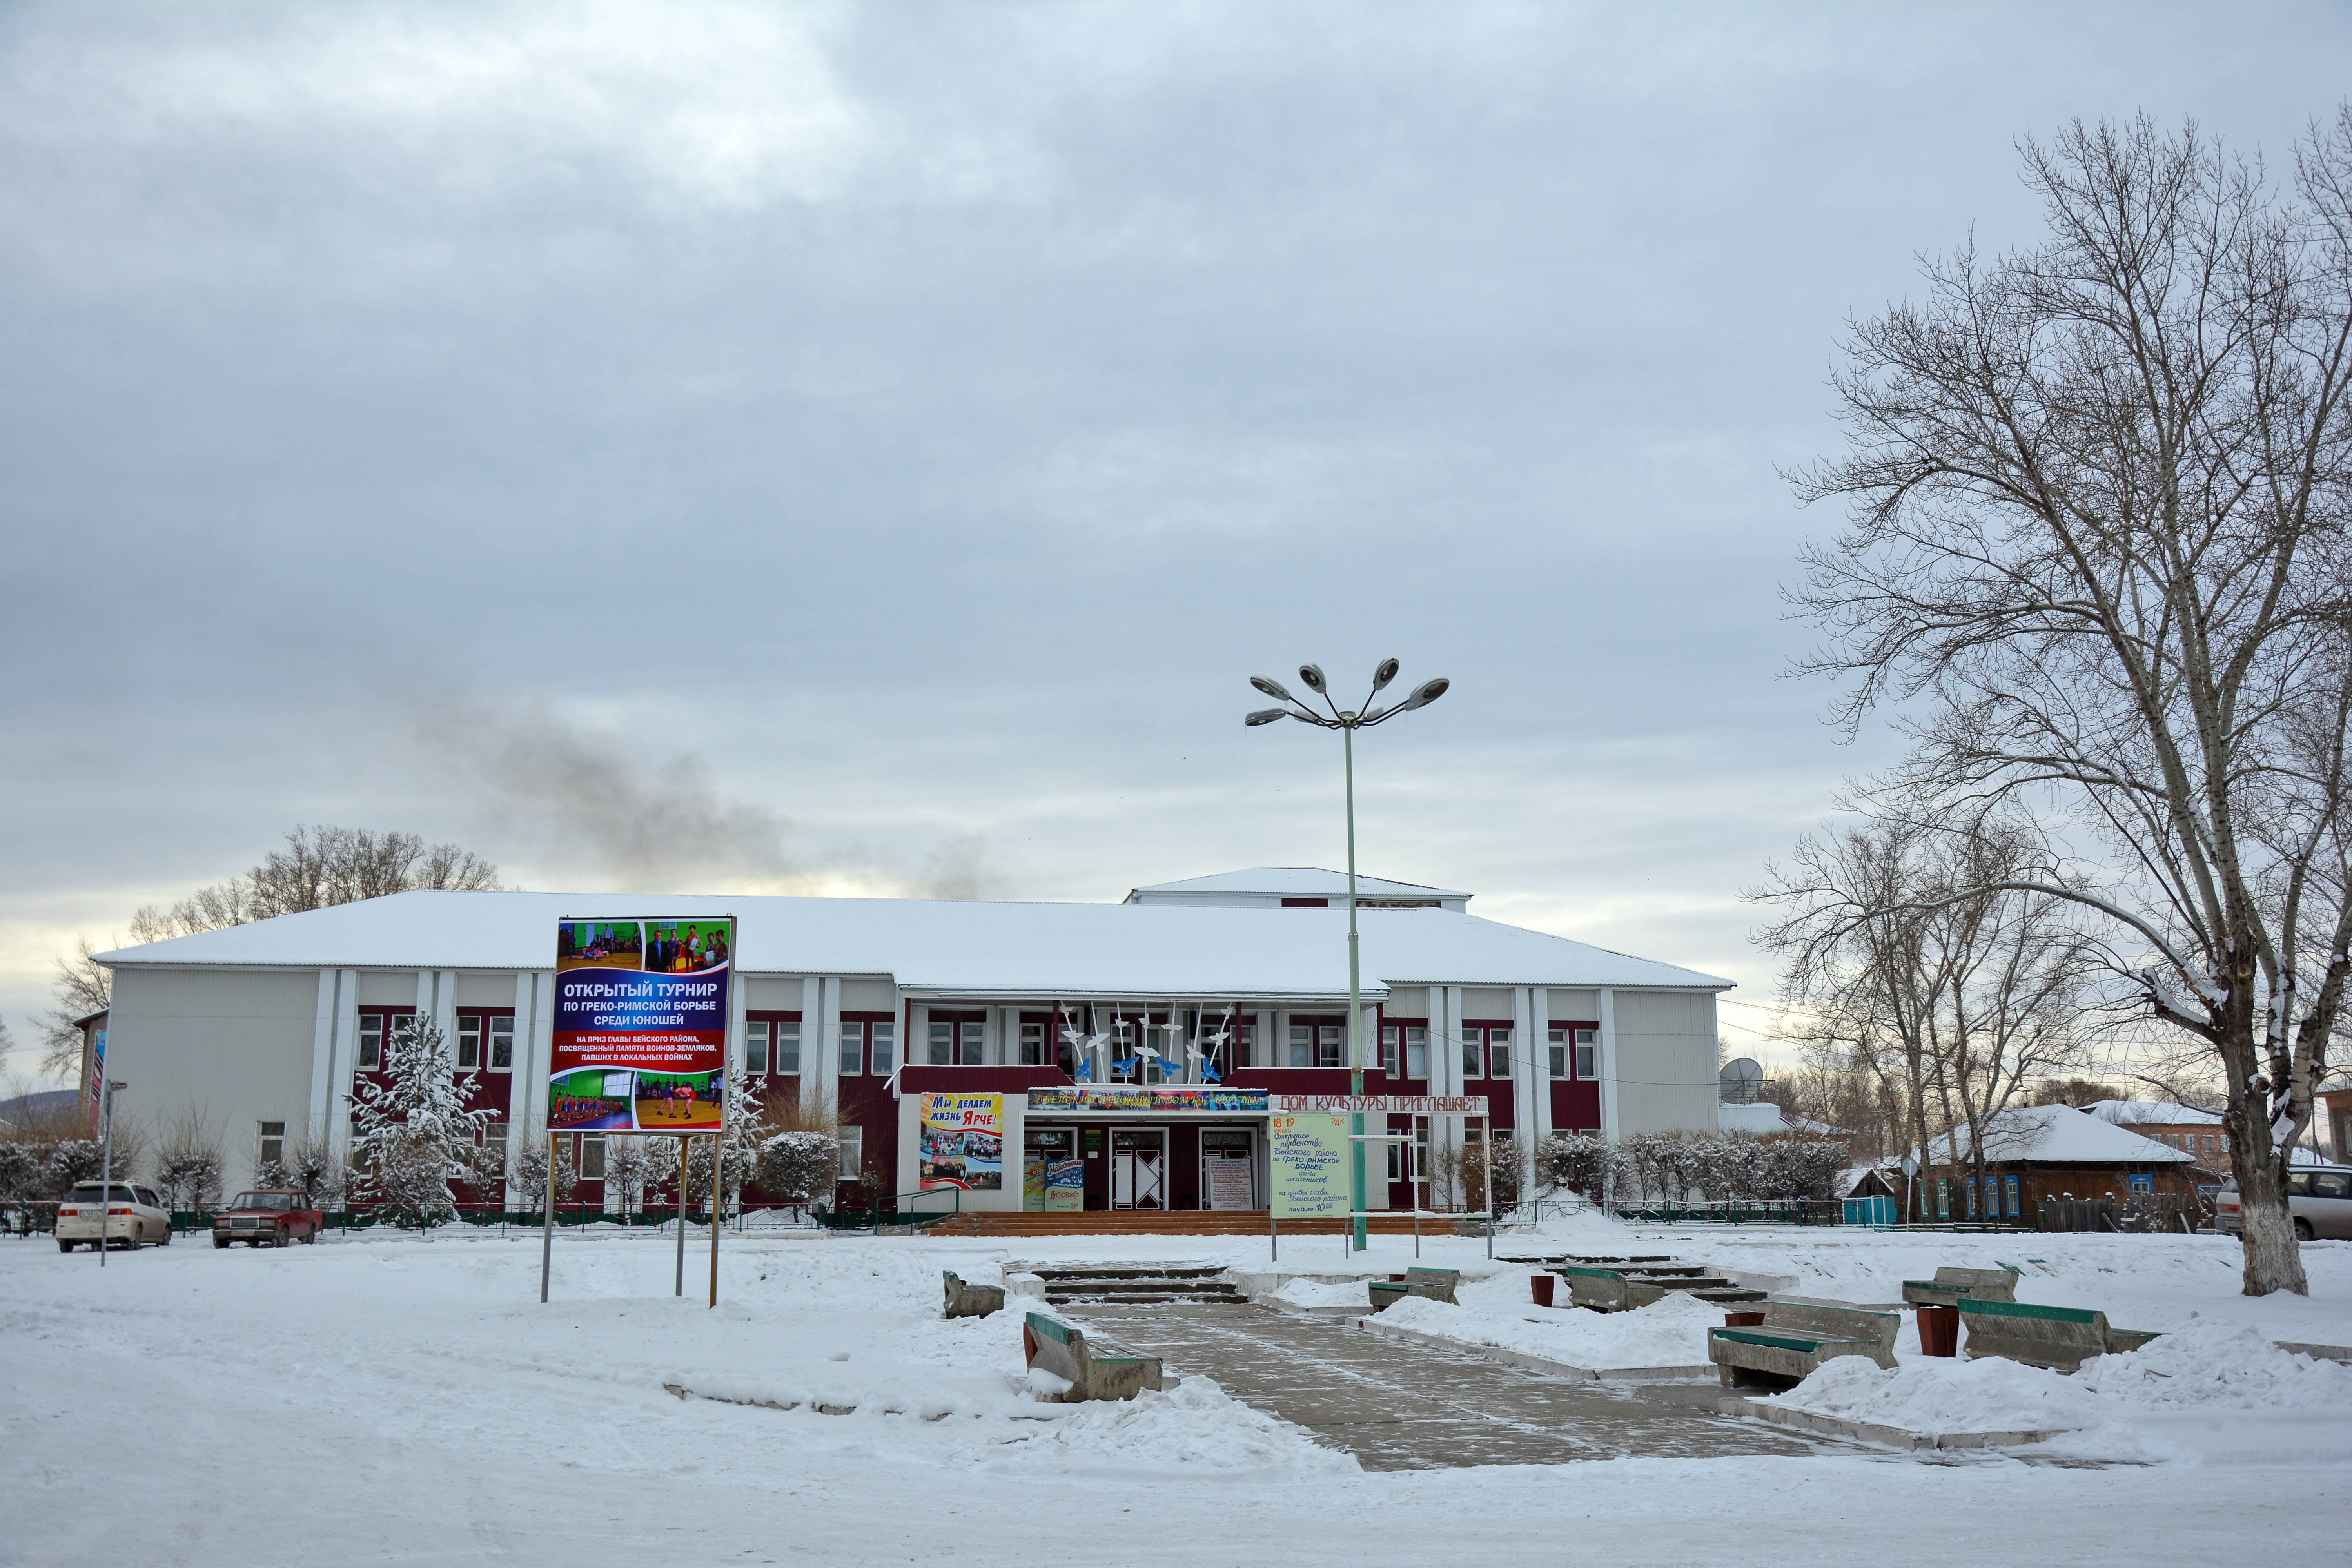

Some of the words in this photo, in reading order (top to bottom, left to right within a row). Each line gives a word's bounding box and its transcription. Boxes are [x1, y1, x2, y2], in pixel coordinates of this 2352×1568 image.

[564, 980, 653, 997] ОТКРЫТЫЙ
[657, 984, 717, 996] ТУРНИР
[564, 1002, 578, 1011] ПО
[581, 1000, 671, 1011] ГРЕКО-РИМСКОЙ
[674, 1001, 716, 1010] БОРЬБЕ
[594, 1016, 630, 1026] СРЕДИ
[633, 1014, 684, 1025] ЮНОШЕЙ
[670, 1034, 699, 1043] РАЙОНА,
[1279, 1096, 1307, 1111] ДОМ
[1316, 1096, 1387, 1111] КУЛЬТУРЫ
[1394, 1096, 1480, 1111] ПРИГЛАШАЕТ
[1273, 1118, 1295, 1128] 18-19
[1280, 1138, 1322, 1149] первенство
[1315, 1149, 1337, 1158] района
[1288, 1190, 1307, 1198] призы
